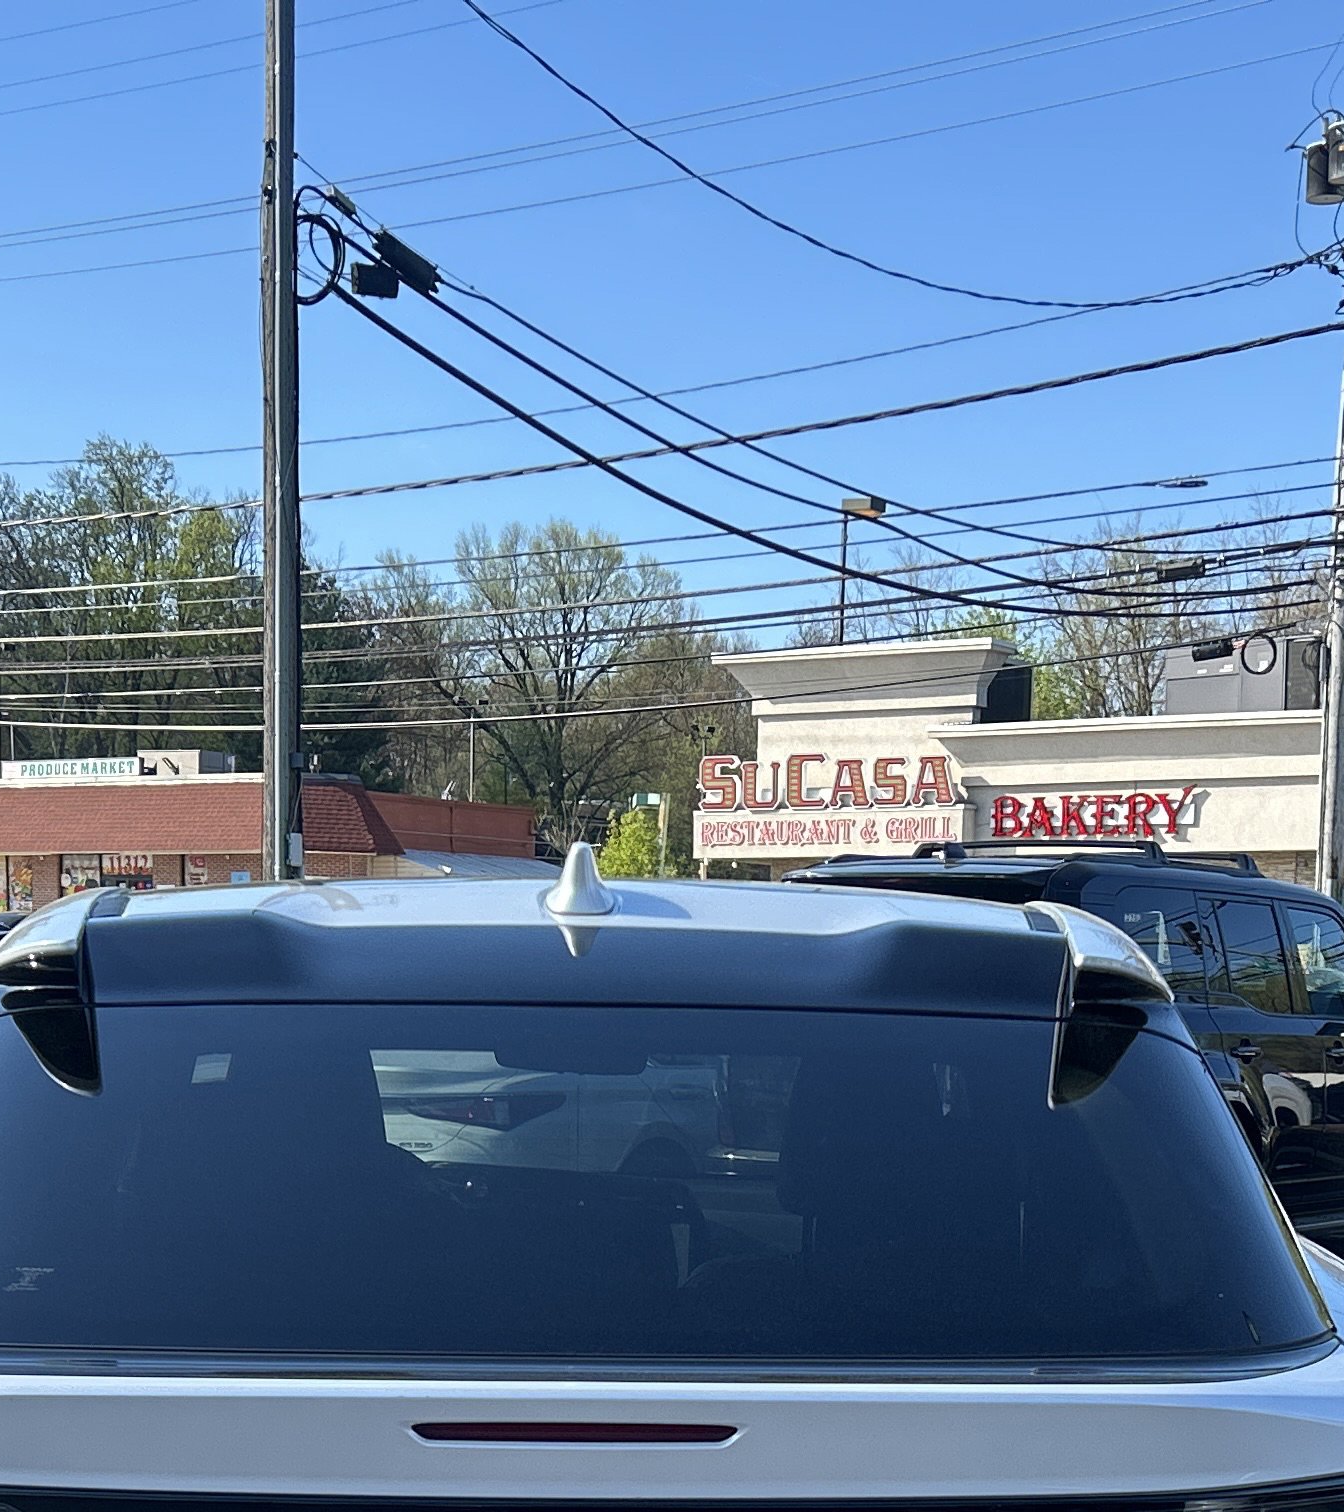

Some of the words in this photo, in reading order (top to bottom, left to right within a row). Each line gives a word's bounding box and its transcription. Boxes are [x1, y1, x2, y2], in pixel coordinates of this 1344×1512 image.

[20, 762, 77, 777] PRODUCE
[80, 760, 135, 775] MARKET
[991, 783, 1198, 838] BAKERY
[701, 818, 856, 847] RESTAURANT
[860, 818, 879, 844] &
[886, 816, 957, 843] GRILL
